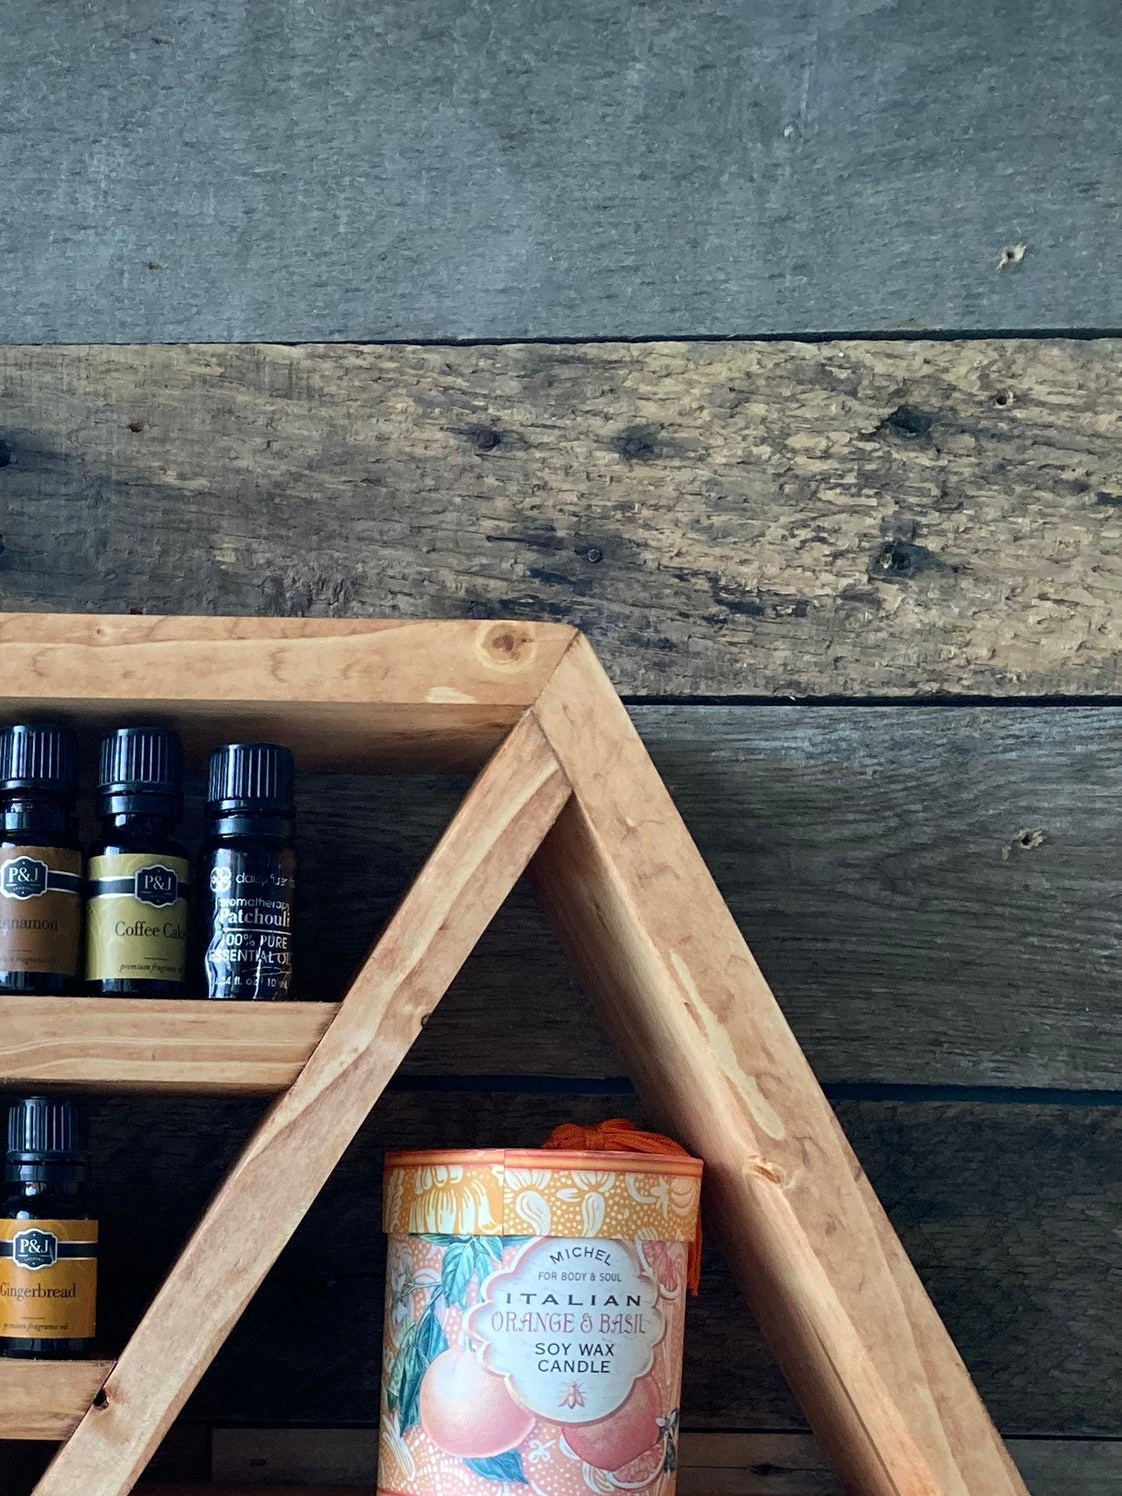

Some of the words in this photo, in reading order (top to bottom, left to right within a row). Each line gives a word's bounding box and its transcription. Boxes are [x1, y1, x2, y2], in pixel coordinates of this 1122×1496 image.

[8, 867, 38, 882] P&J
[144, 875, 171, 891] P&J
[115, 921, 160, 937] Coffee
[20, 1239, 49, 1253] P&J
[549, 1246, 612, 1267] MICHEL
[538, 1271, 557, 1281] FOR
[561, 1272, 586, 1281] BODY
[590, 1273, 596, 1281] &
[599, 1272, 622, 1282] SOUL
[0, 1282, 77, 1300] Gingerbread
[506, 1293, 641, 1307] ITALIAN
[491, 1311, 575, 1334] ORANGE
[580, 1312, 593, 1333] &
[599, 1313, 646, 1334] BASIL
[535, 1342, 572, 1356] SOY
[578, 1343, 615, 1357] WAX
[538, 1360, 611, 1373] CANDLE
